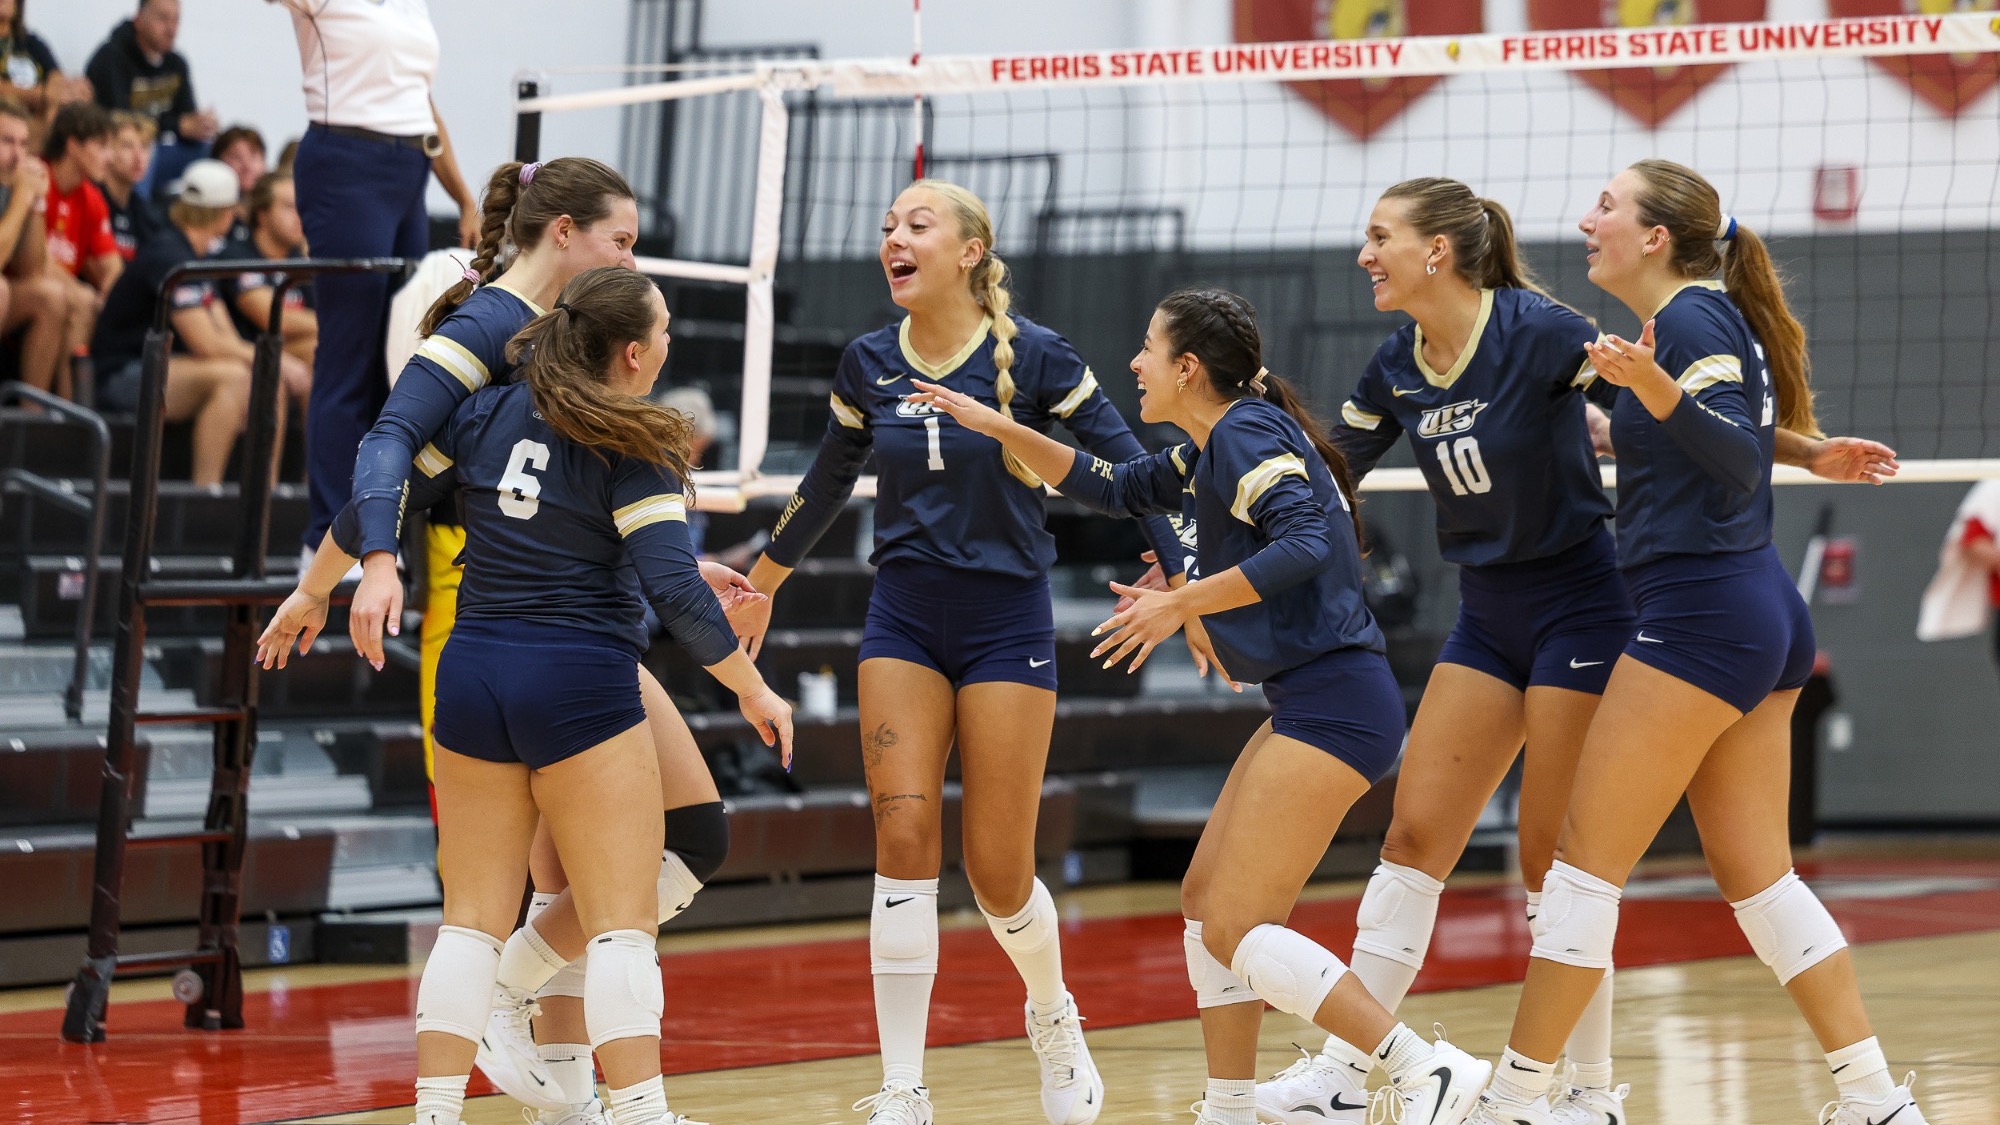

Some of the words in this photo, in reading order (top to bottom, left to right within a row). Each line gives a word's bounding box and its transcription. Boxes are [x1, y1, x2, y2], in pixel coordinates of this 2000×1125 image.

[1503, 34, 1617, 62] FERRIS
[1628, 29, 1728, 57] STATE
[1738, 18, 1943, 52] UNIVERSITY
[991, 54, 1101, 82] FERRIS
[1110, 50, 1202, 77] STATE
[1212, 43, 1404, 72] UNIVERSITY
[1418, 400, 1482, 437] UIS
[924, 416, 945, 471] 1
[1435, 435, 1492, 496] 10
[496, 438, 551, 521] 6
[1090, 455, 1114, 482] PR
